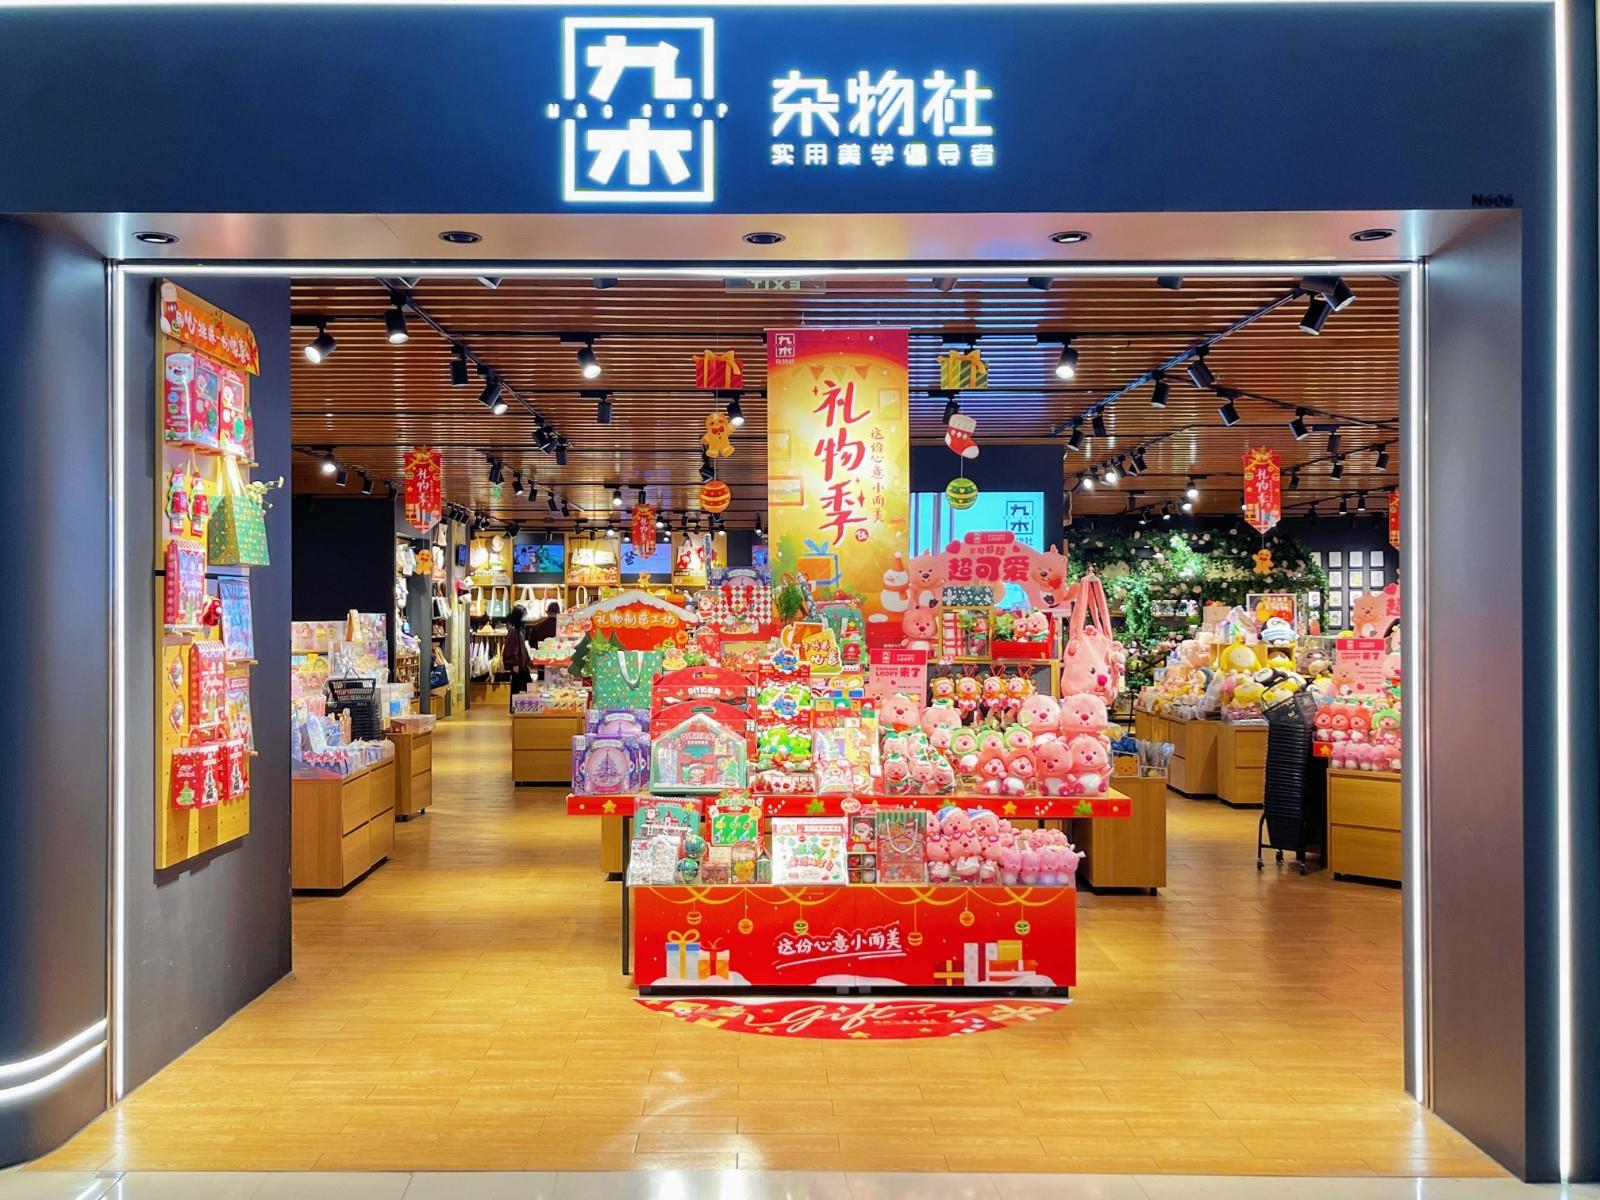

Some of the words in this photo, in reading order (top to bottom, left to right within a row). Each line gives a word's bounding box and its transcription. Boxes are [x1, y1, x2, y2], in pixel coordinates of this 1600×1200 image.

[643, 103, 728, 119] SHOP
[772, 70, 995, 137] 杂物社
[771, 143, 995, 166] 实用美学倡导者
[1471, 193, 1515, 207] N606
[813, 380, 871, 546] 礼物季
[870, 427, 885, 524] 这份心意小而美
[948, 556, 1030, 581] 超可爱
[777, 927, 901, 955] 这份心意小而美
[780, 1003, 896, 1033] Gift
